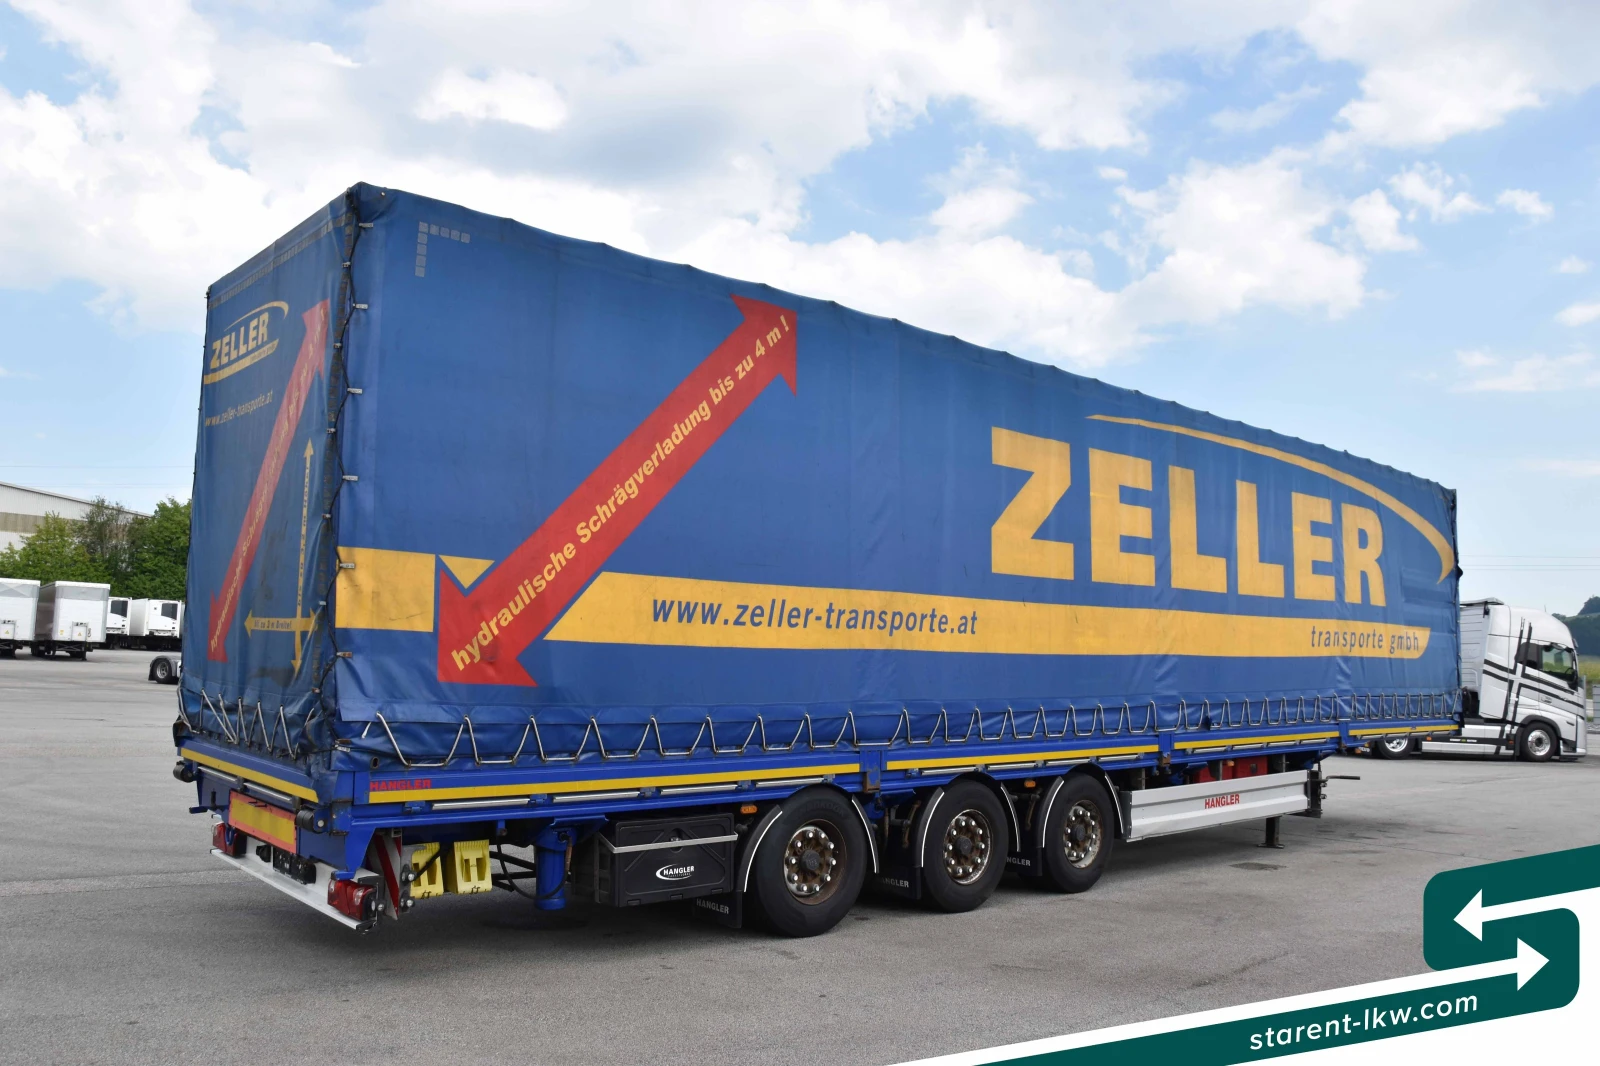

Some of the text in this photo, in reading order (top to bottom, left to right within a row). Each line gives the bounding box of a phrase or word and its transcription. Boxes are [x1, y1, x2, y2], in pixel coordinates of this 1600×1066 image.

[210, 312, 269, 369] ZELLER
[205, 388, 274, 427] www.zeller-transporte.at
[450, 315, 790, 671] hydraulische Schrägverladung bis zu 4 m !
[991, 426, 1387, 607] ZELLER
[652, 598, 978, 637] www.zeller-transporte.at
[1311, 625, 1419, 654] transporte gmbh
[369, 778, 432, 792] HANGLER
[1204, 794, 1240, 809] HANGLER
[663, 865, 695, 876] HANGLER
[1006, 856, 1031, 867] NGLER
[696, 898, 730, 915] HANGLER
